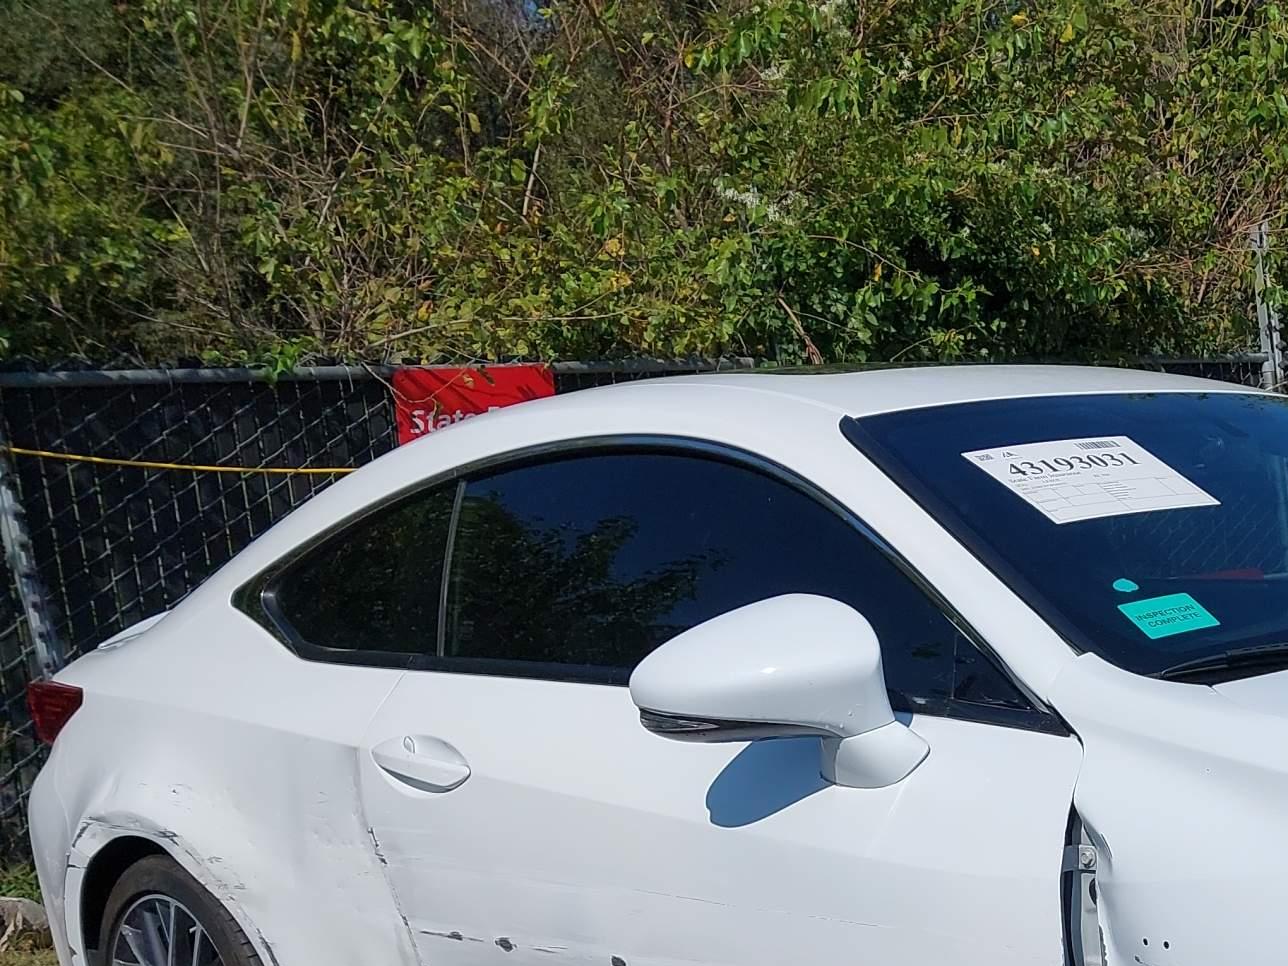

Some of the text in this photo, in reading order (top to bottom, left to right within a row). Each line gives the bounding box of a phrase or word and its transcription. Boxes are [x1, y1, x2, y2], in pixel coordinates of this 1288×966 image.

[1009, 453, 1141, 476] 43193031
[1135, 604, 1195, 622] INSPECTION
[1148, 612, 1201, 627] COMPLETE
